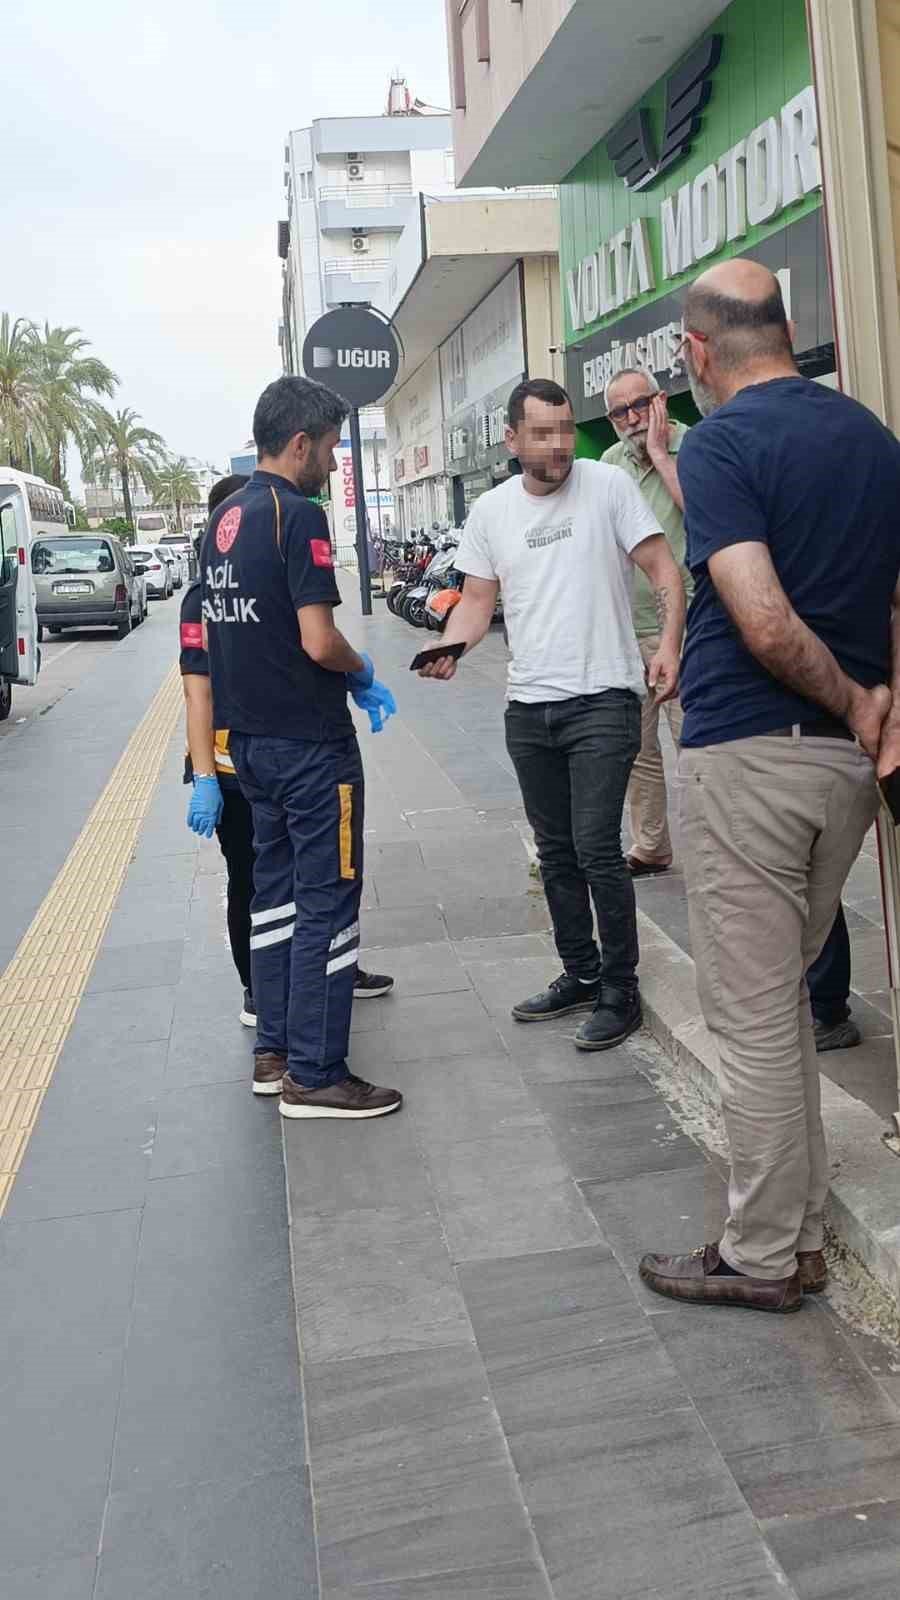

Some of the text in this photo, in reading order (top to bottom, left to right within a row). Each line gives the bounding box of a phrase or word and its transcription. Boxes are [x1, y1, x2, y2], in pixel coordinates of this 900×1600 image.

[566, 85, 822, 331] VOLTA MOTOR
[336, 347, 391, 369] UĞUR
